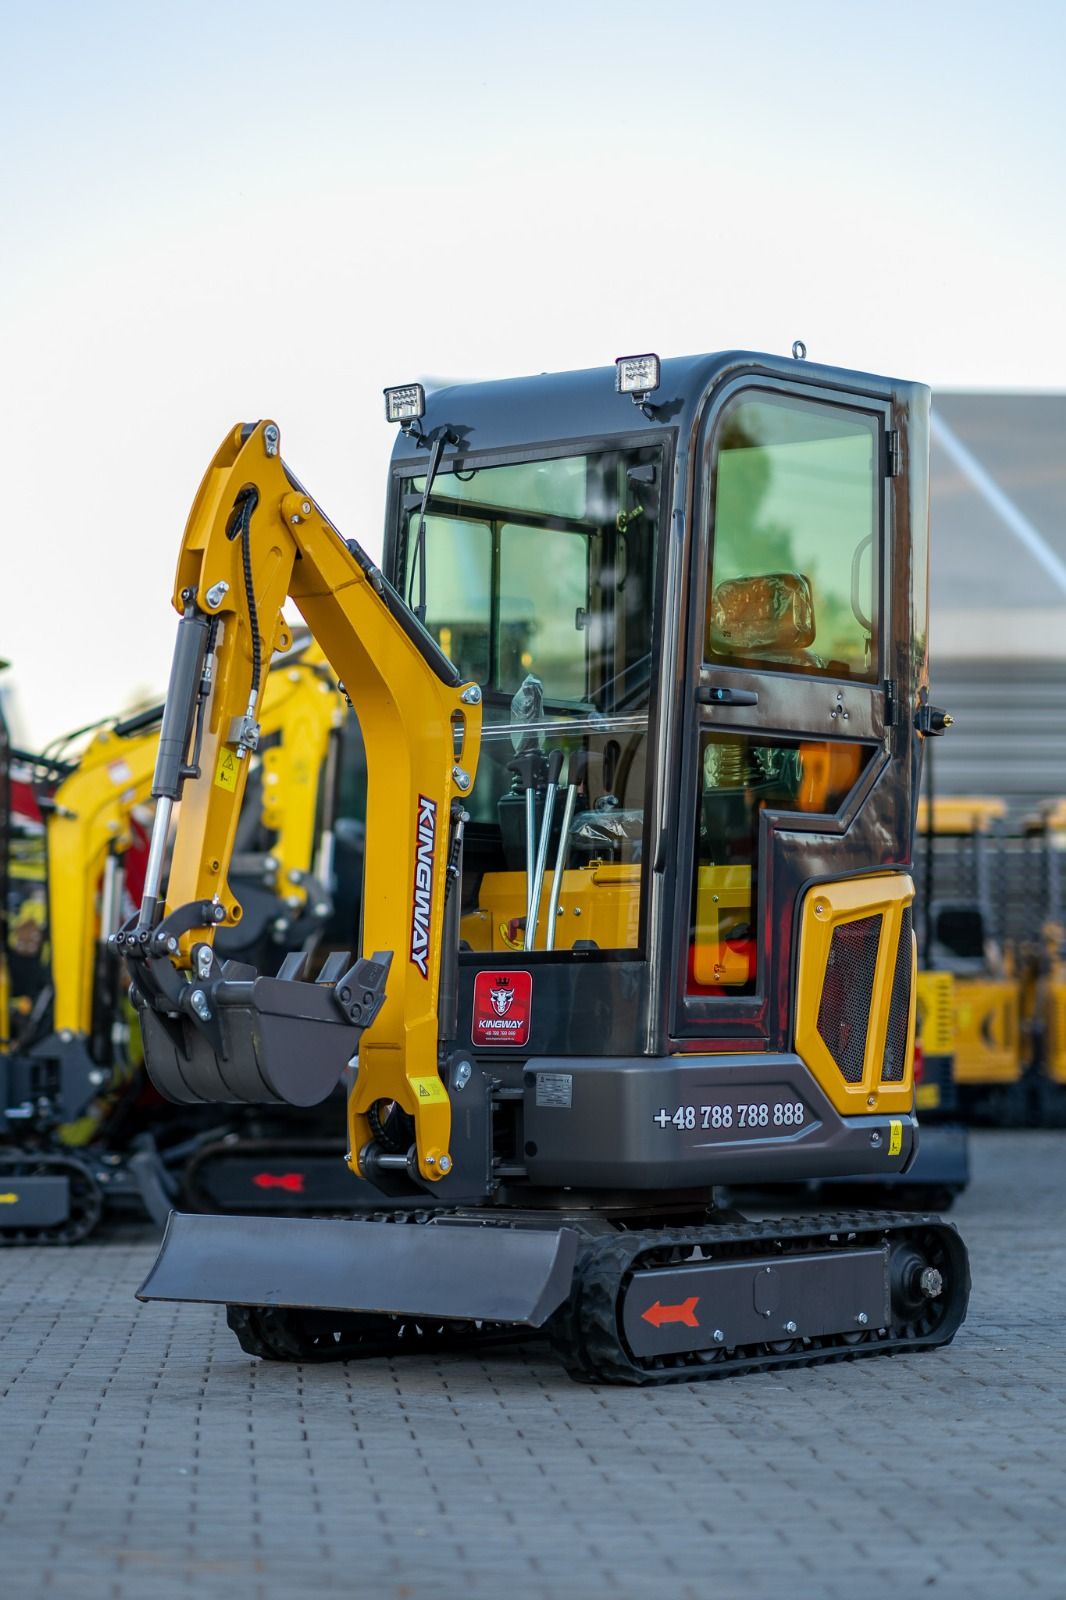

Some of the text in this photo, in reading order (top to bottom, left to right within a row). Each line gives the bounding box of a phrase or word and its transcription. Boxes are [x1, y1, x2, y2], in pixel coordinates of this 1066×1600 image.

[410, 796, 437, 978] KINGWAY
[478, 1019, 524, 1029] KINGWAY
[653, 1102, 804, 1130] +48 788 788 888
